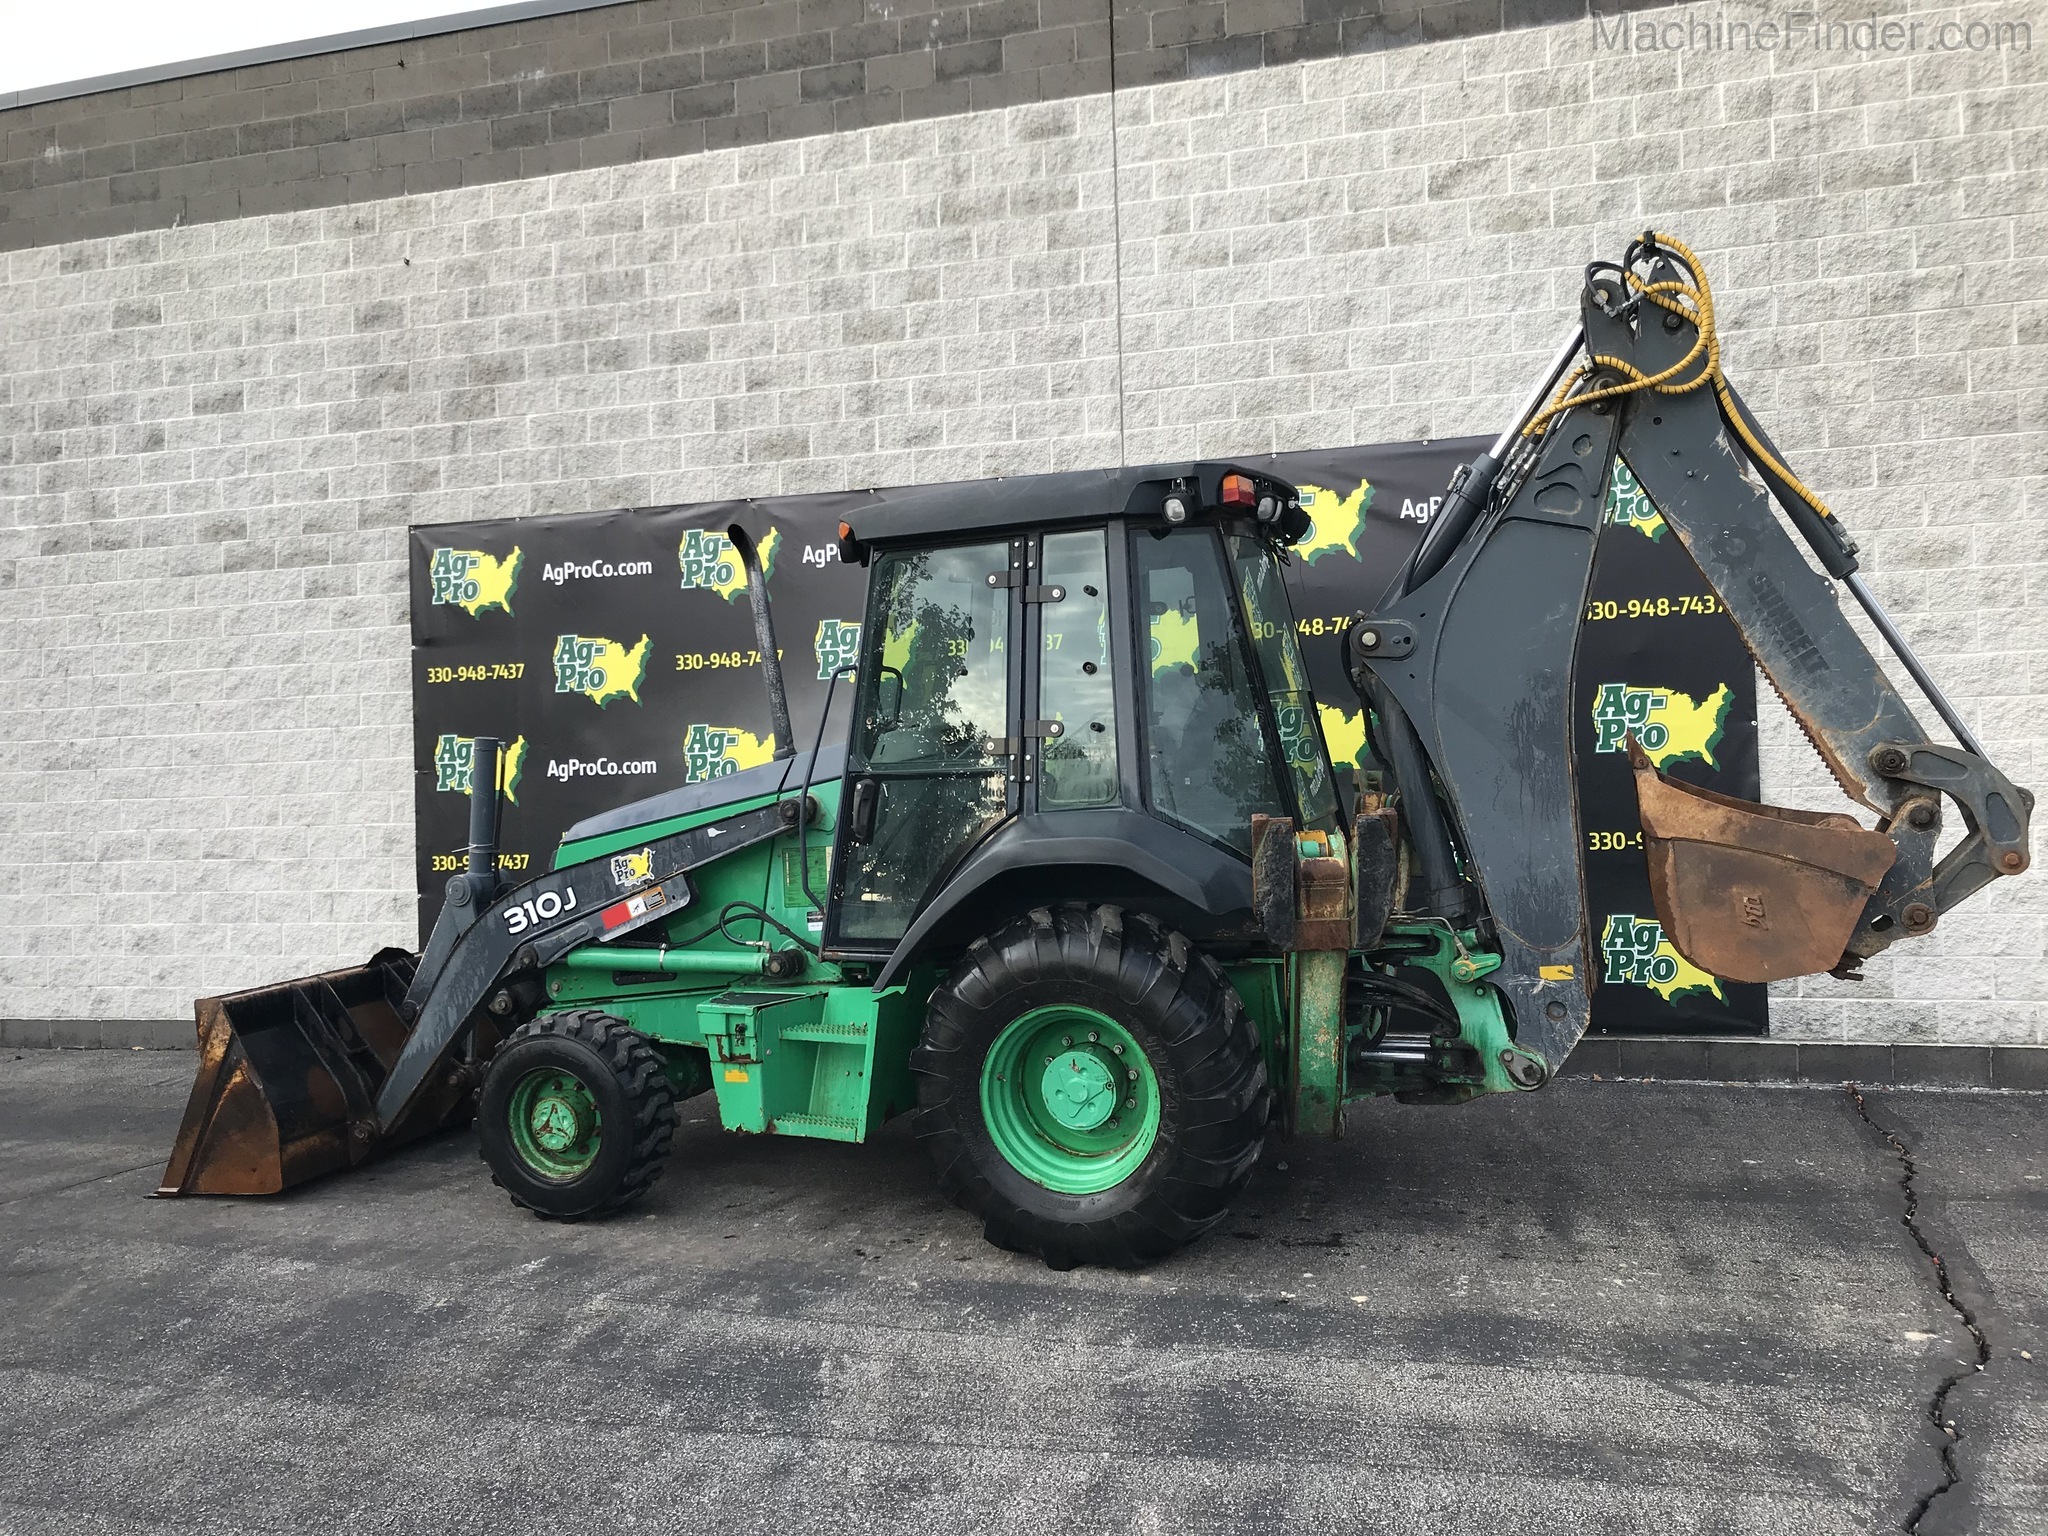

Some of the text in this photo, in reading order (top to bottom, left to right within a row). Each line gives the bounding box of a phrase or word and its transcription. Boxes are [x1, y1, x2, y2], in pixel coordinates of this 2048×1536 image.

[680, 529, 733, 563] Ag-
[432, 548, 479, 581] Ag-
[542, 560, 653, 585] AgProCo.com
[680, 558, 735, 588] Pro
[432, 575, 480, 604] Pro
[555, 634, 606, 668] Ag-
[817, 619, 860, 656] Ag
[427, 663, 525, 683] 330-948-7437
[675, 649, 784, 671] 330-948-747
[555, 662, 607, 692] Pro
[1594, 683, 1667, 725] Ag-
[437, 734, 475, 768] Ag
[684, 724, 739, 760] Ag-
[547, 757, 657, 782] AgProCo.com
[685, 753, 740, 783] Pro
[614, 859, 632, 871] Ag-
[616, 868, 636, 881] Pro
[503, 886, 577, 934] 310J
[1604, 949, 1678, 984] Pro
